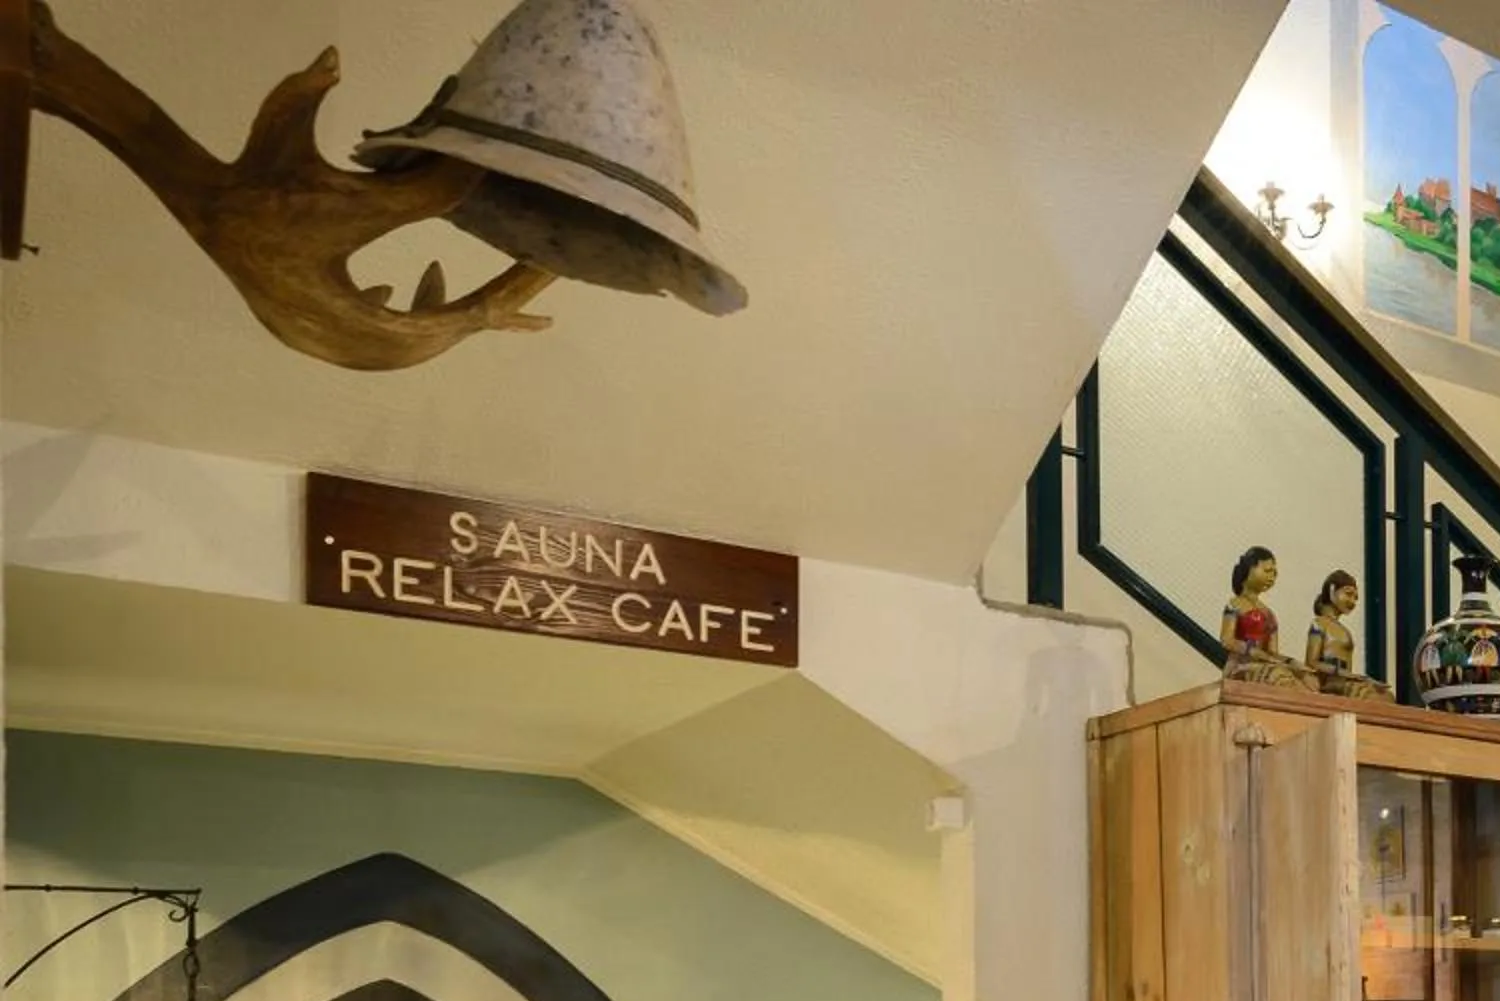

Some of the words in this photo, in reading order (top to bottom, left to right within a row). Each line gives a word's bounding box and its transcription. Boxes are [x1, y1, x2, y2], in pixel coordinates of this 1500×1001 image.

[449, 511, 667, 586] SAUNA
[340, 549, 578, 626] RELAX
[611, 592, 775, 652] CAFE
